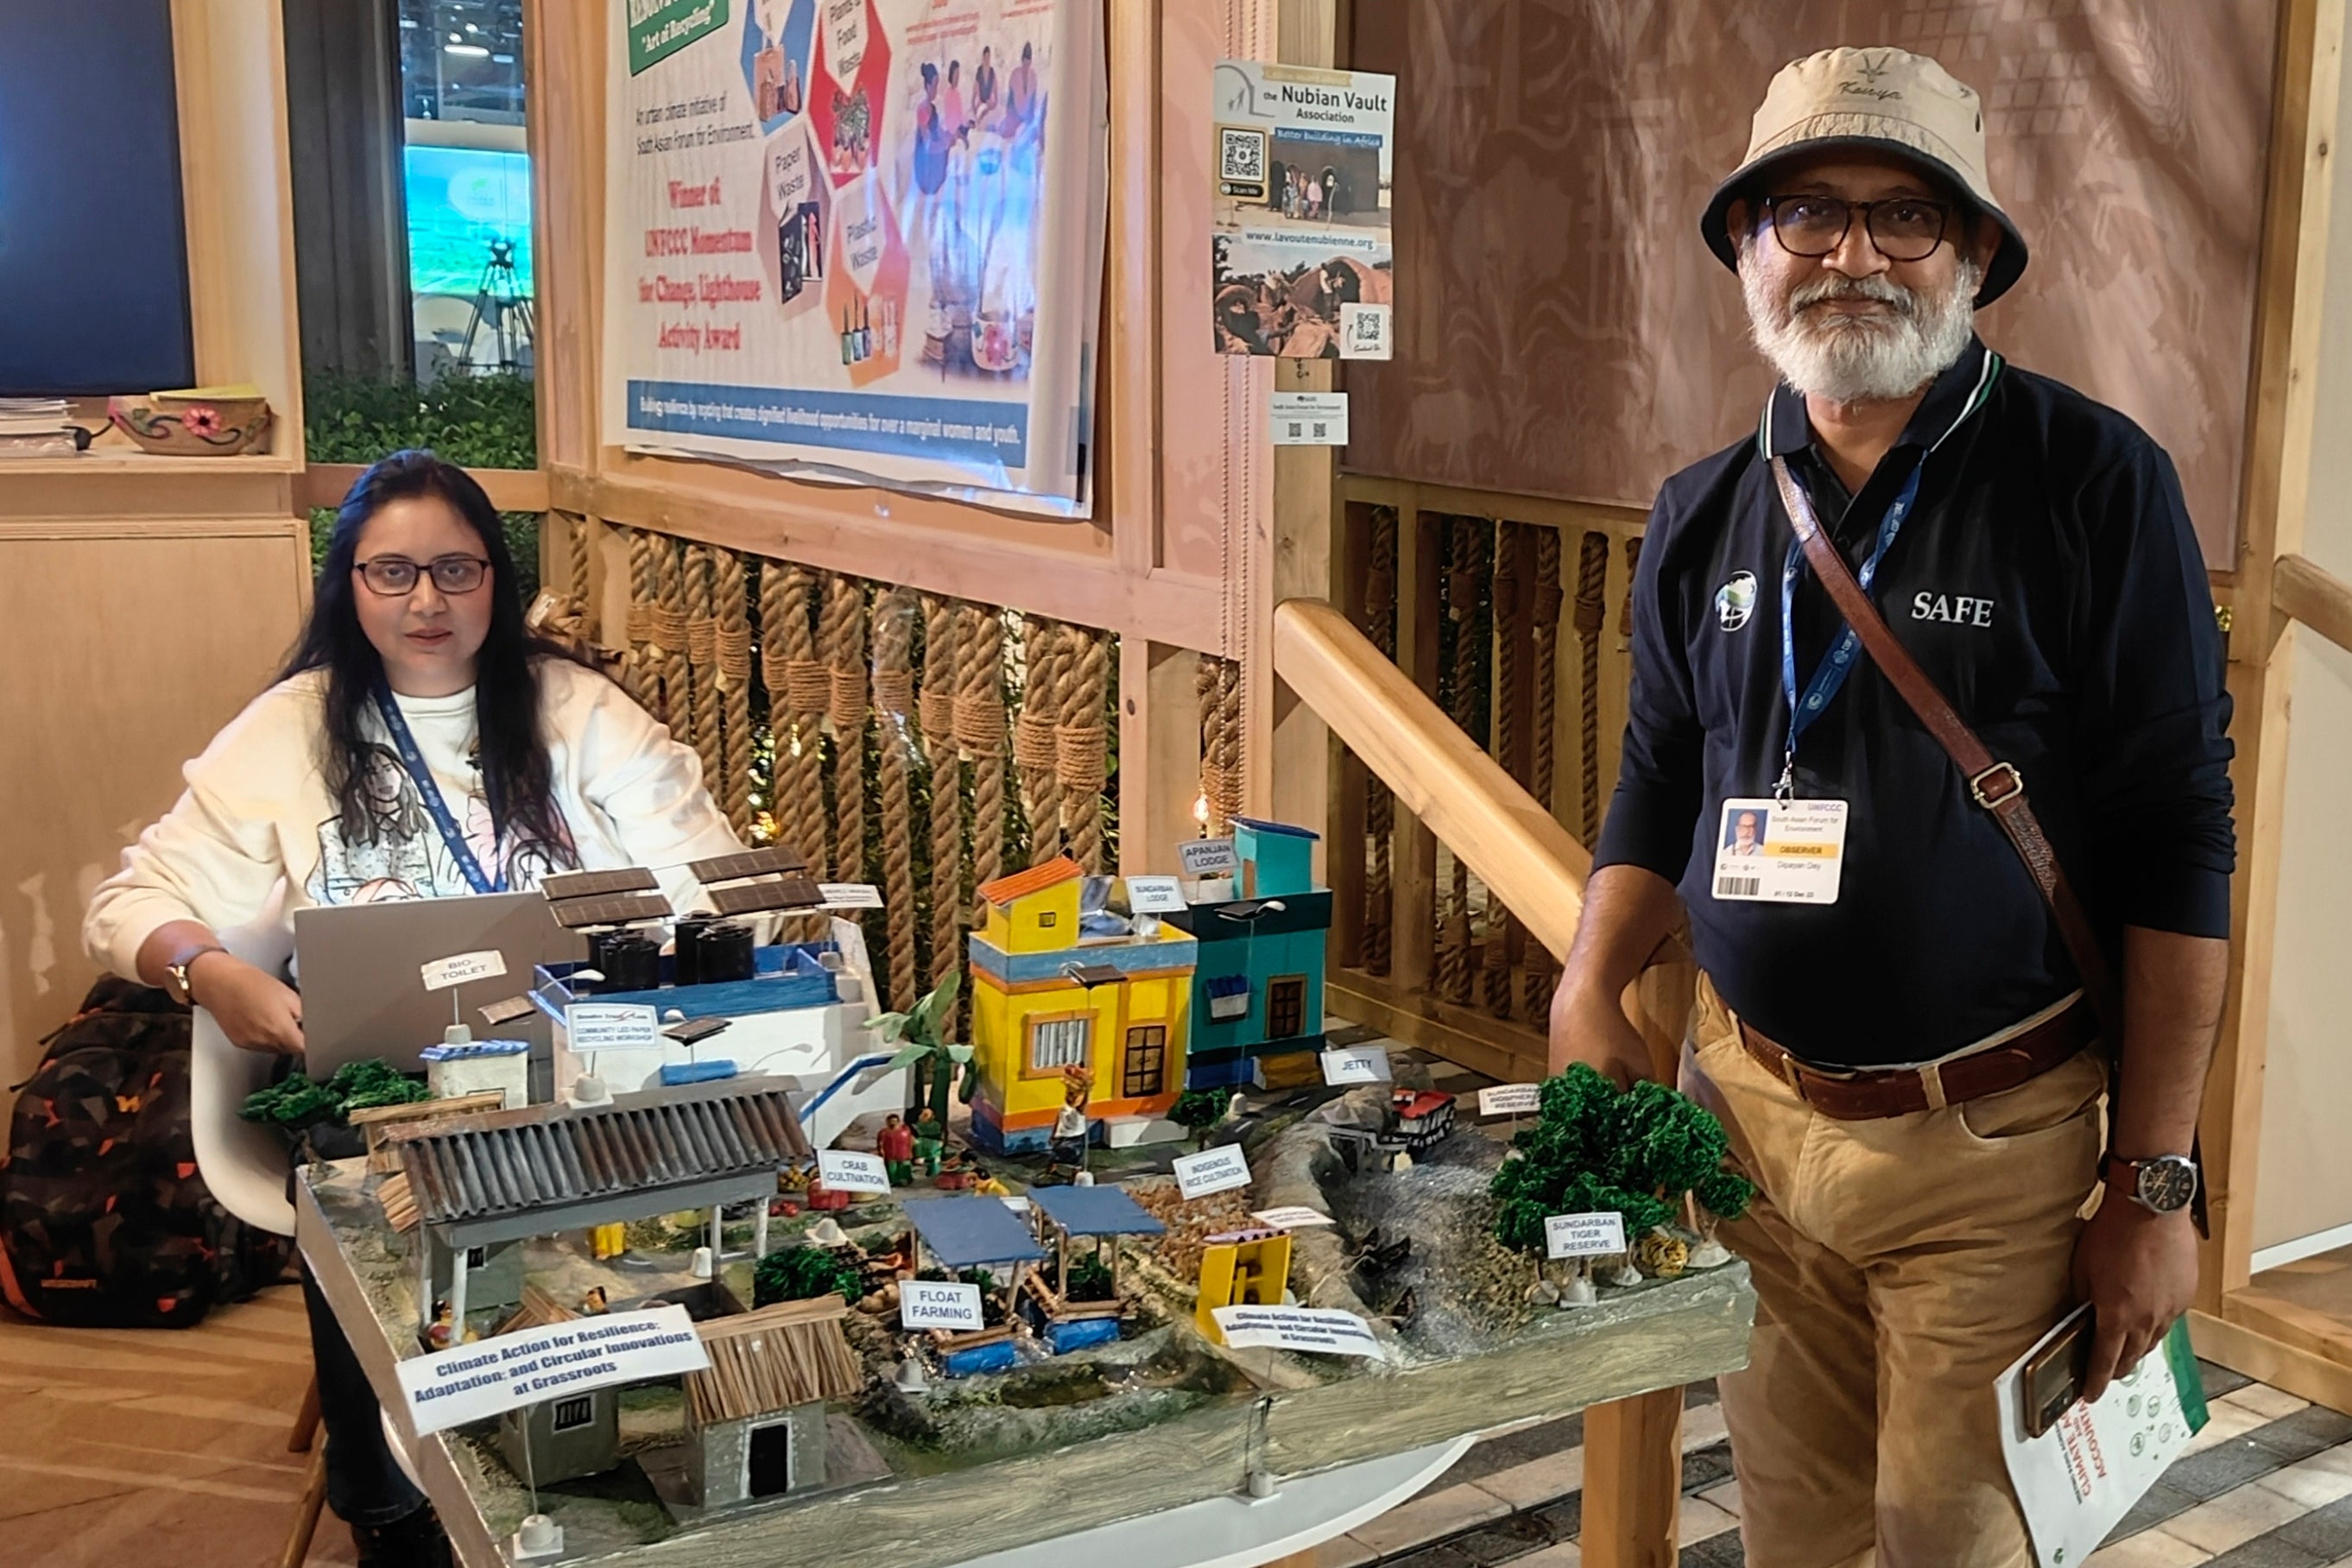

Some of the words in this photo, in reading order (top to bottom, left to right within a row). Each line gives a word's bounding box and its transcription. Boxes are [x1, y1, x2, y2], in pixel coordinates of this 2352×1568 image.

[837, 21, 857, 49] Food
[1263, 92, 1278, 101] the
[1282, 85, 1340, 107] Nubian
[1344, 92, 1388, 111] Vault
[1838, 81, 1903, 101] Kenya
[1296, 108, 1355, 123] Association
[775, 147, 800, 174] Paper
[777, 174, 805, 200] Waste
[1246, 231, 1373, 250] www.lavoutenubienne.org
[704, 321, 741, 351] Award
[1911, 591, 1995, 629] SAFE
[1780, 845, 1823, 855] OBSERVER
[1194, 855, 1230, 868] LODGE
[441, 965, 486, 980] TOILET
[1342, 1059, 1373, 1071] JETTY
[842, 1160, 869, 1172] CRAB
[1192, 1156, 1232, 1174] INDIGENOUS
[827, 1172, 885, 1185] CULTIVATION
[1203, 1167, 1243, 1184] CULTIVATION
[1552, 1218, 1616, 1231] SUNDARBAN
[1571, 1229, 1602, 1240] TIGER
[1564, 1239, 1611, 1251] RESERVE
[920, 1290, 962, 1303] FLOAT
[912, 1306, 972, 1320] FARMING
[1236, 1312, 1271, 1321] Climate
[1272, 1312, 1299, 1322] Action
[436, 1353, 499, 1377] Climate
[501, 1339, 552, 1361] Action
[553, 1335, 575, 1349] for
[577, 1320, 661, 1344] Resilience:
[509, 1360, 540, 1379] and
[541, 1345, 604, 1369] Circular
[605, 1331, 693, 1355] Innovations
[513, 1381, 531, 1396] at
[532, 1361, 617, 1390] Grassroots
[2077, 1396, 2107, 1479] ACCOUNTA
[2066, 1432, 2091, 1496] CLIMATE
